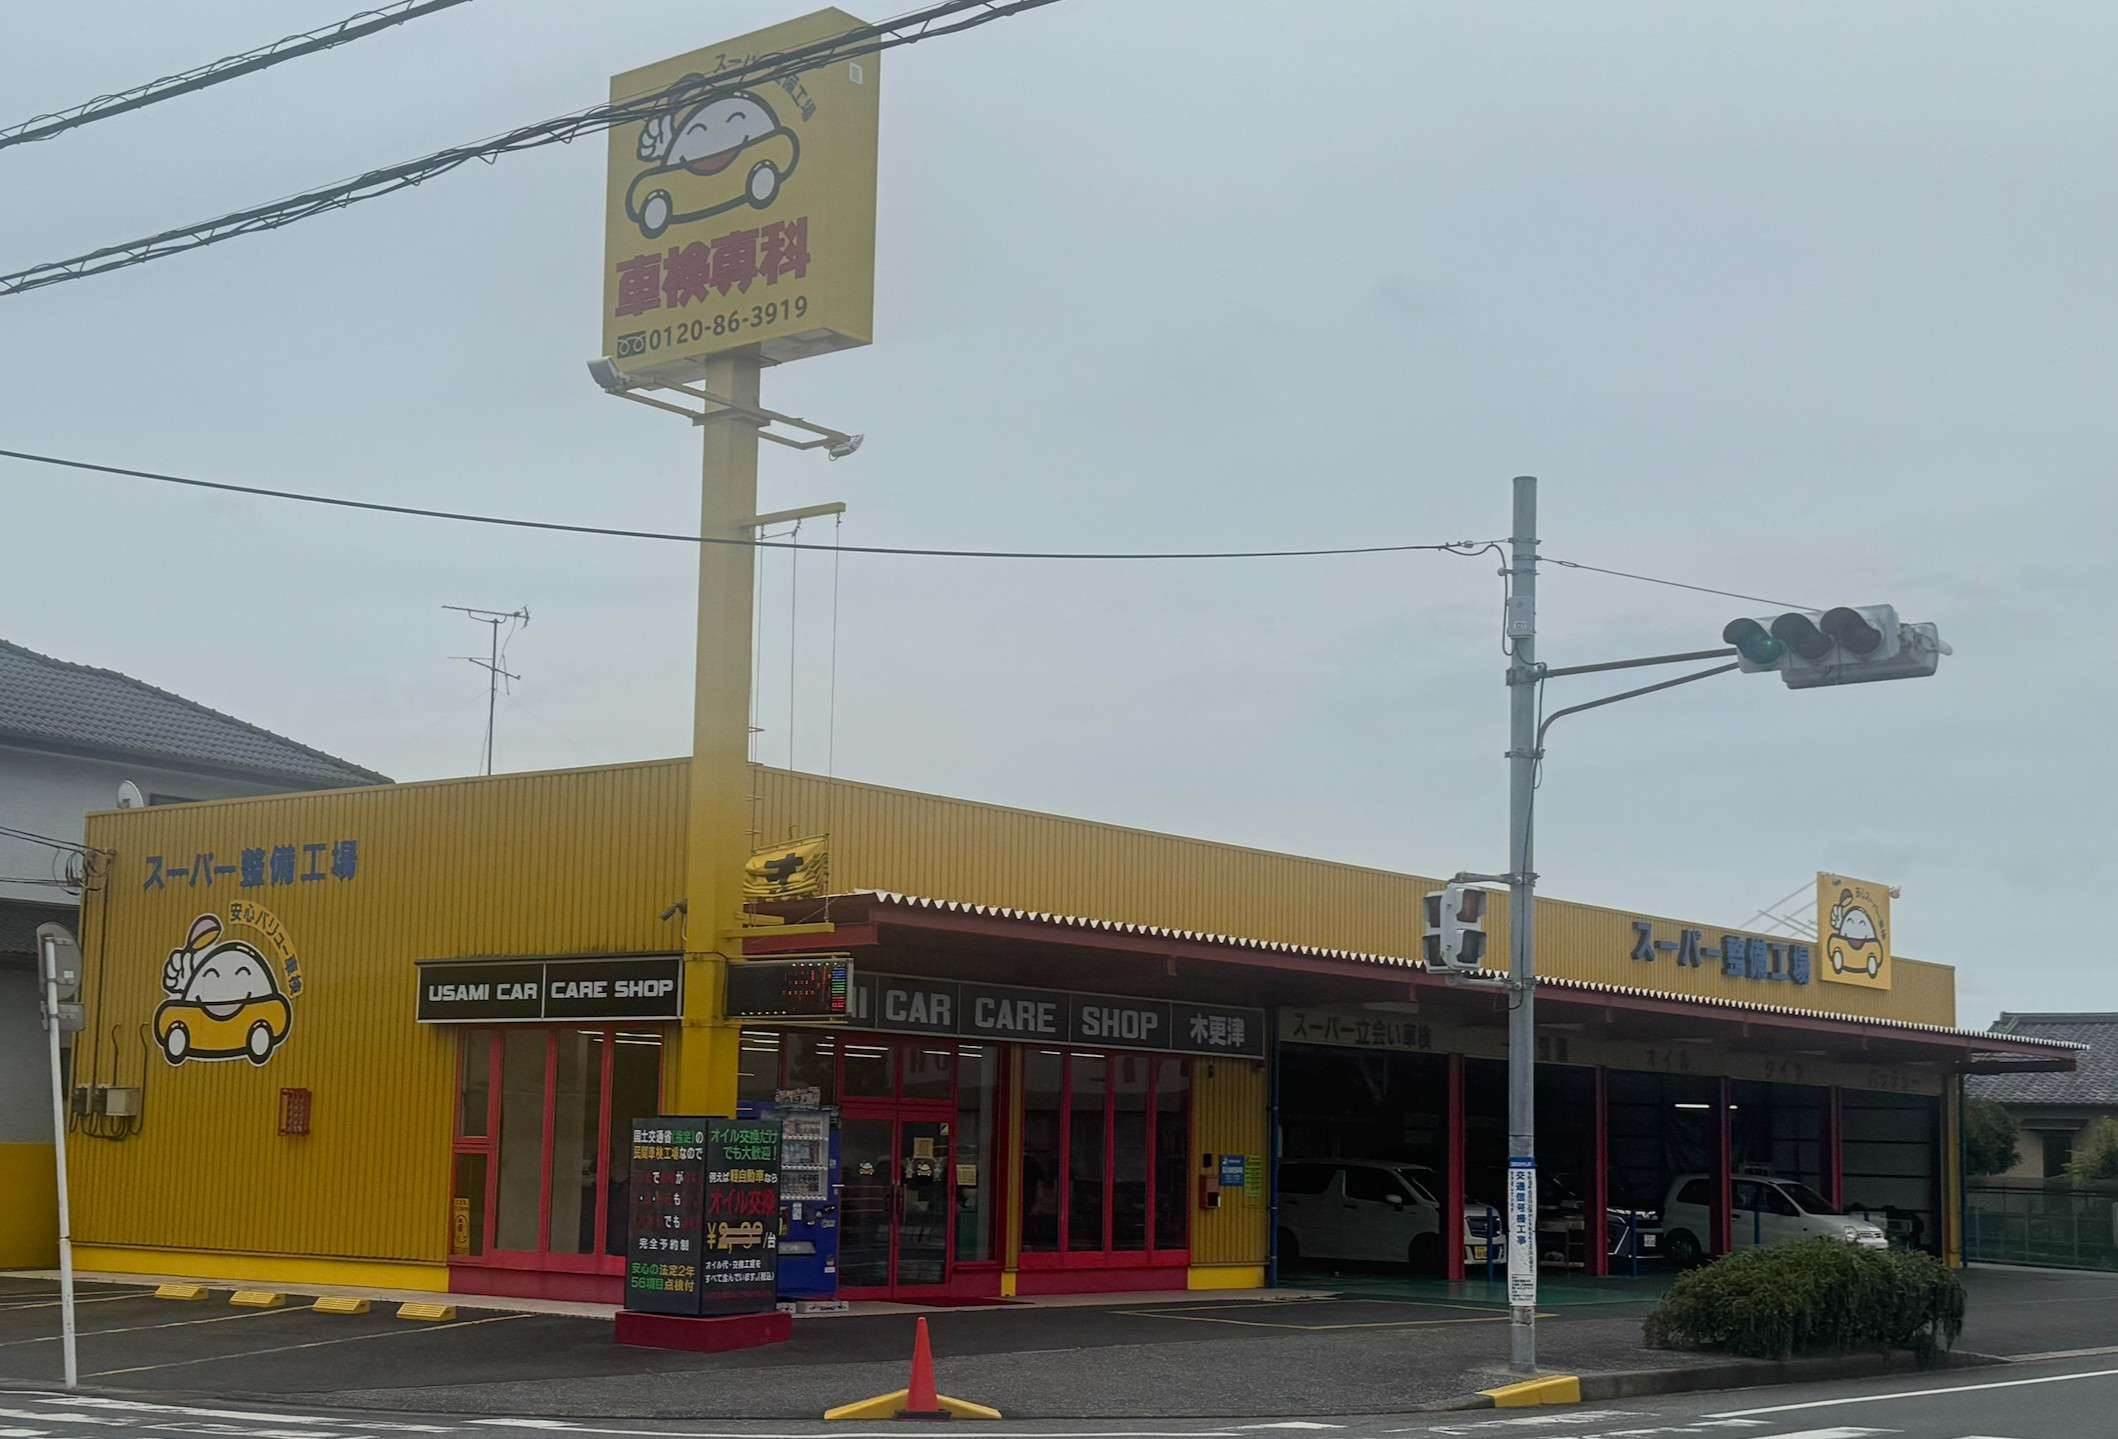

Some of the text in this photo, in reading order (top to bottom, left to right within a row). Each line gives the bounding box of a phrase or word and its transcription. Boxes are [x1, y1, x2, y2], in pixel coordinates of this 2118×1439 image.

[615, 216, 811, 317] 車検専科
[649, 296, 808, 350] 0120-86-3919
[143, 840, 358, 890] スーパー整備工場
[1631, 921, 1810, 985] スーパー整備工場
[429, 979, 673, 1001] USAMI CAR CARE SHOP
[885, 989, 951, 1026] CAR
[975, 998, 1057, 1034] CARE
[1082, 1006, 1159, 1041] SHOP
[1189, 1013, 1246, 1048] 木更津
